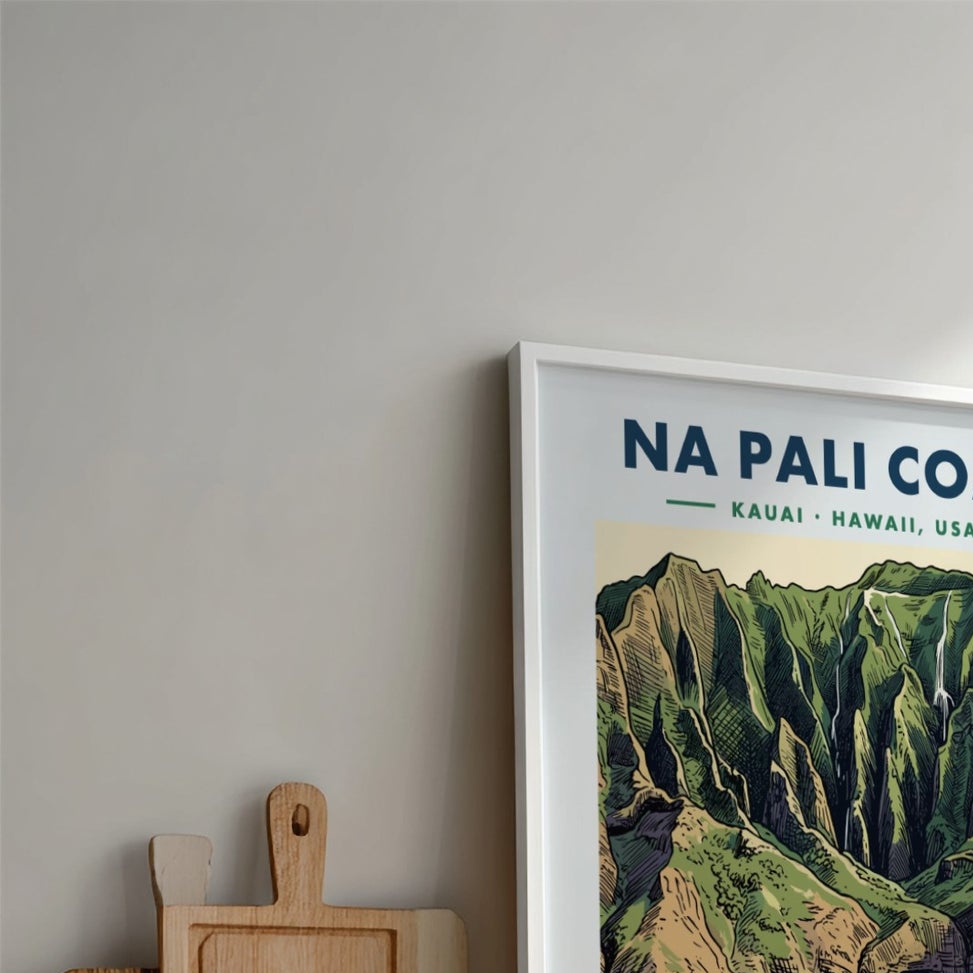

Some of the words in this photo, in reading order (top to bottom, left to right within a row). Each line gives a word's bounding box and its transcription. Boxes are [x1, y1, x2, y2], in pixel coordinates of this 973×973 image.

[623, 418, 719, 477] NA
[739, 429, 866, 491] PALI
[731, 500, 803, 524] KAUAI
[832, 510, 923, 536] HAWAII,
